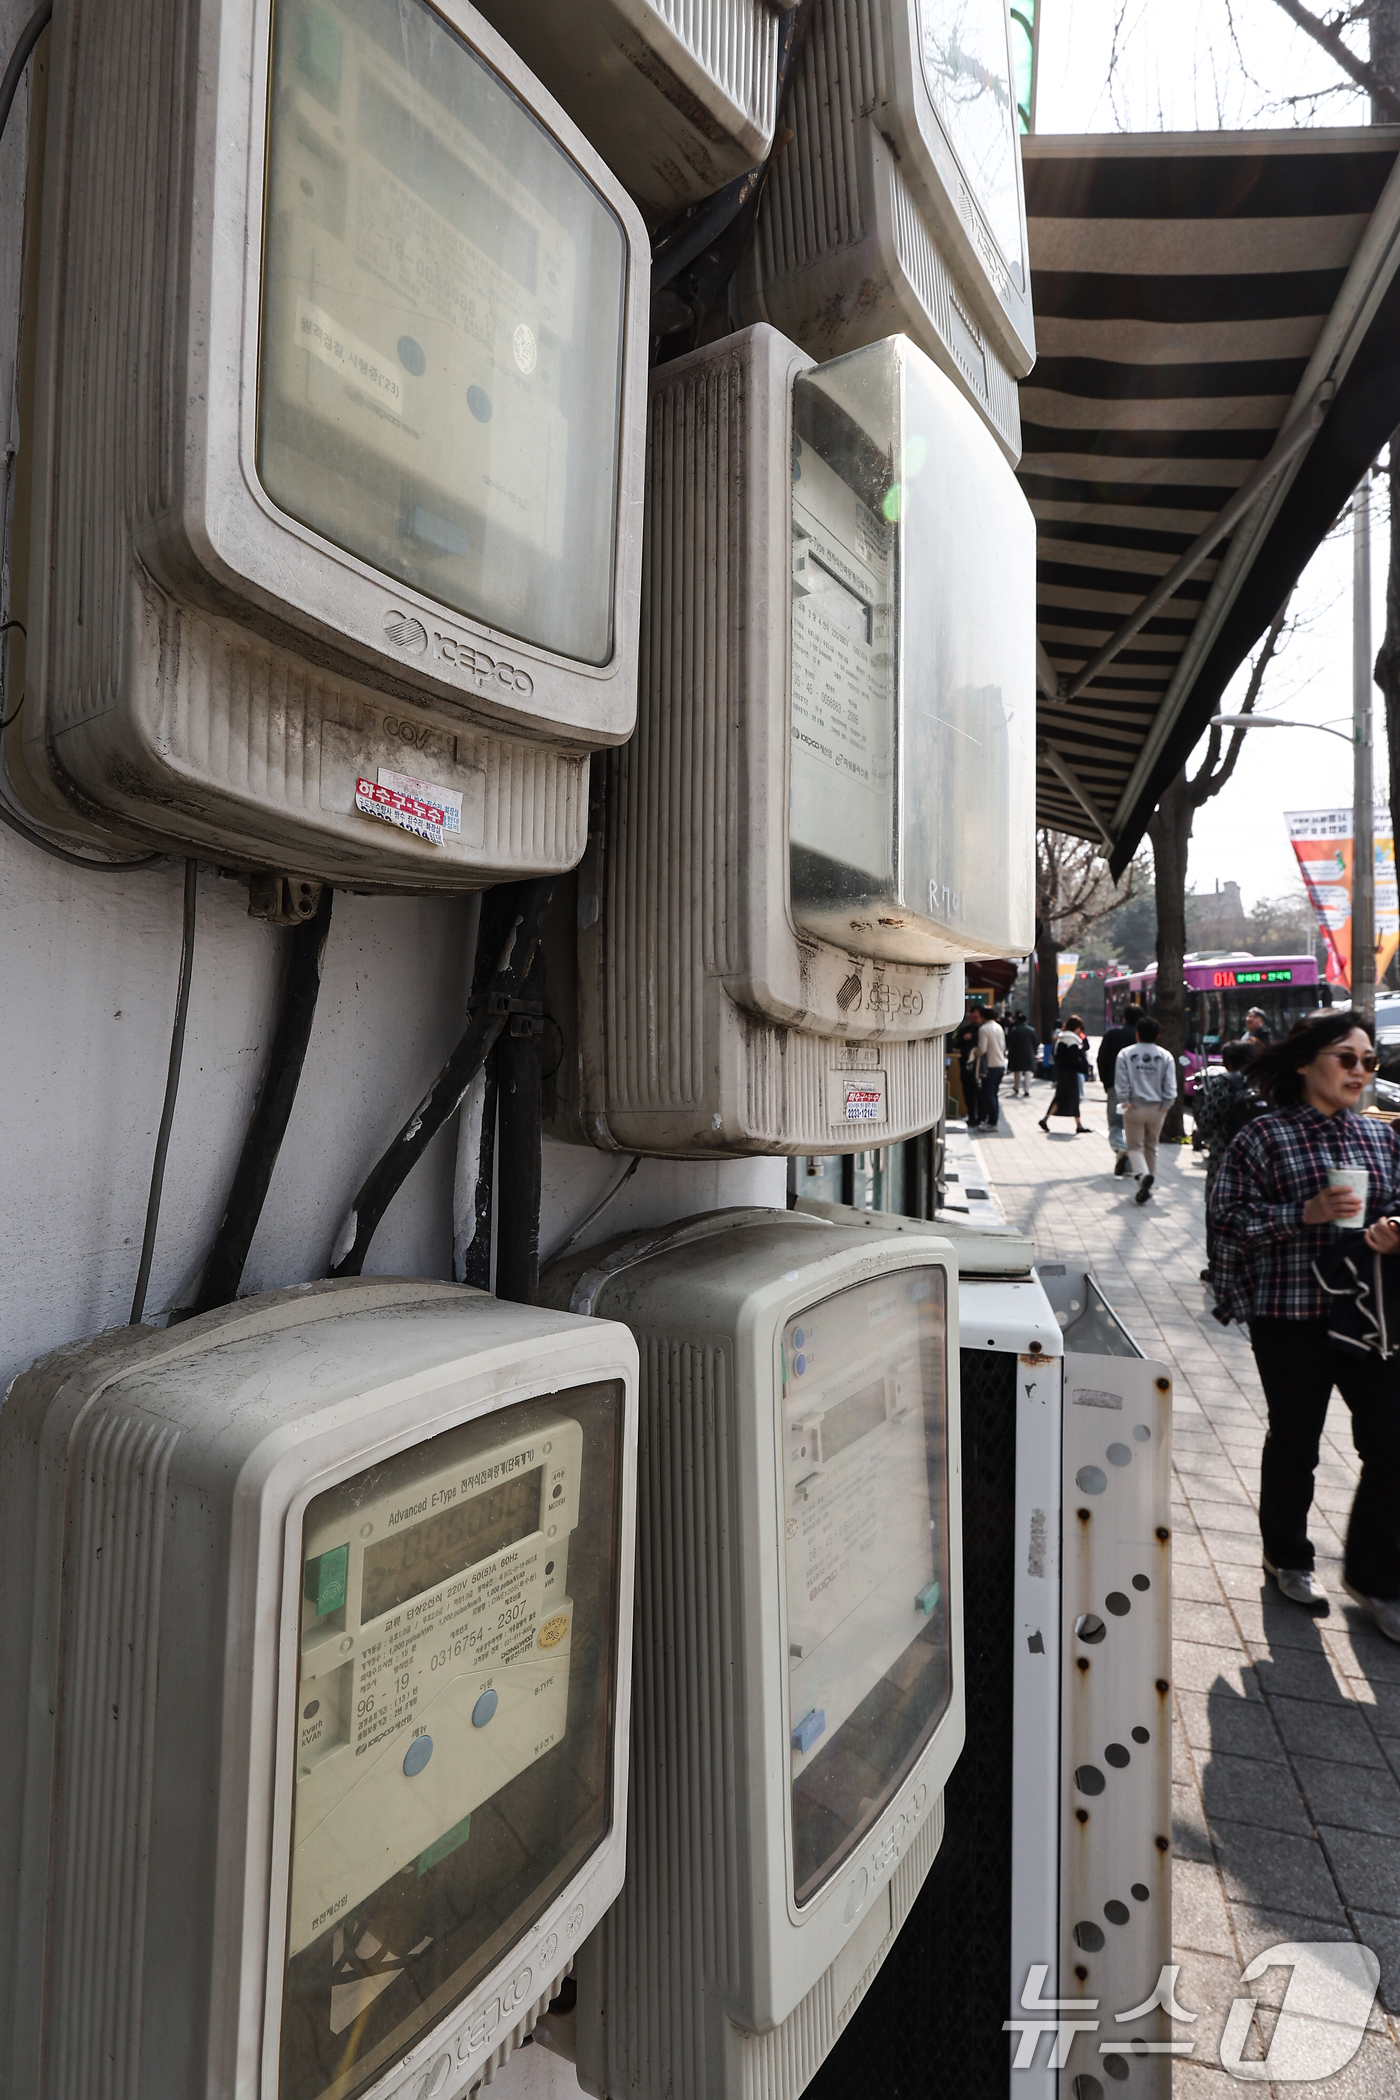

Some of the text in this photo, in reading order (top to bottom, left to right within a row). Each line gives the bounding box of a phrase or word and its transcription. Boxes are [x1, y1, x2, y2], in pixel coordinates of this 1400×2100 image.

[302, 317, 343, 358] 원격검침
[433, 631, 535, 697] KEPCO
[801, 733, 819, 749] KEPCO
[1214, 971, 1236, 987] 01A
[388, 1448, 534, 1526] Advanced E-Type 전자식전력량계(단독계기)
[548, 1496, 565, 1510] MODEM
[384, 1552, 518, 1632] 교류 단상2선식 220V 50(5)A 60Hz
[388, 1640, 404, 1654] 1,000
[405, 1624, 433, 1647] pulse/kWh
[438, 1612, 452, 1625] 1,000
[486, 1584, 499, 1597] 1,000
[357, 1599, 526, 1717] 96 19 0316754 2307
[401, 1648, 408, 1657] 15
[479, 1677, 493, 1691] 이동
[534, 1676, 553, 1695] B-TYPE
[302, 1720, 323, 1736] kvarh
[411, 1724, 426, 1738] 메뉴
[302, 1730, 322, 1747] kVAh
[312, 1894, 348, 1931] 한전재산임
[455, 1966, 533, 2074] KEPCO
